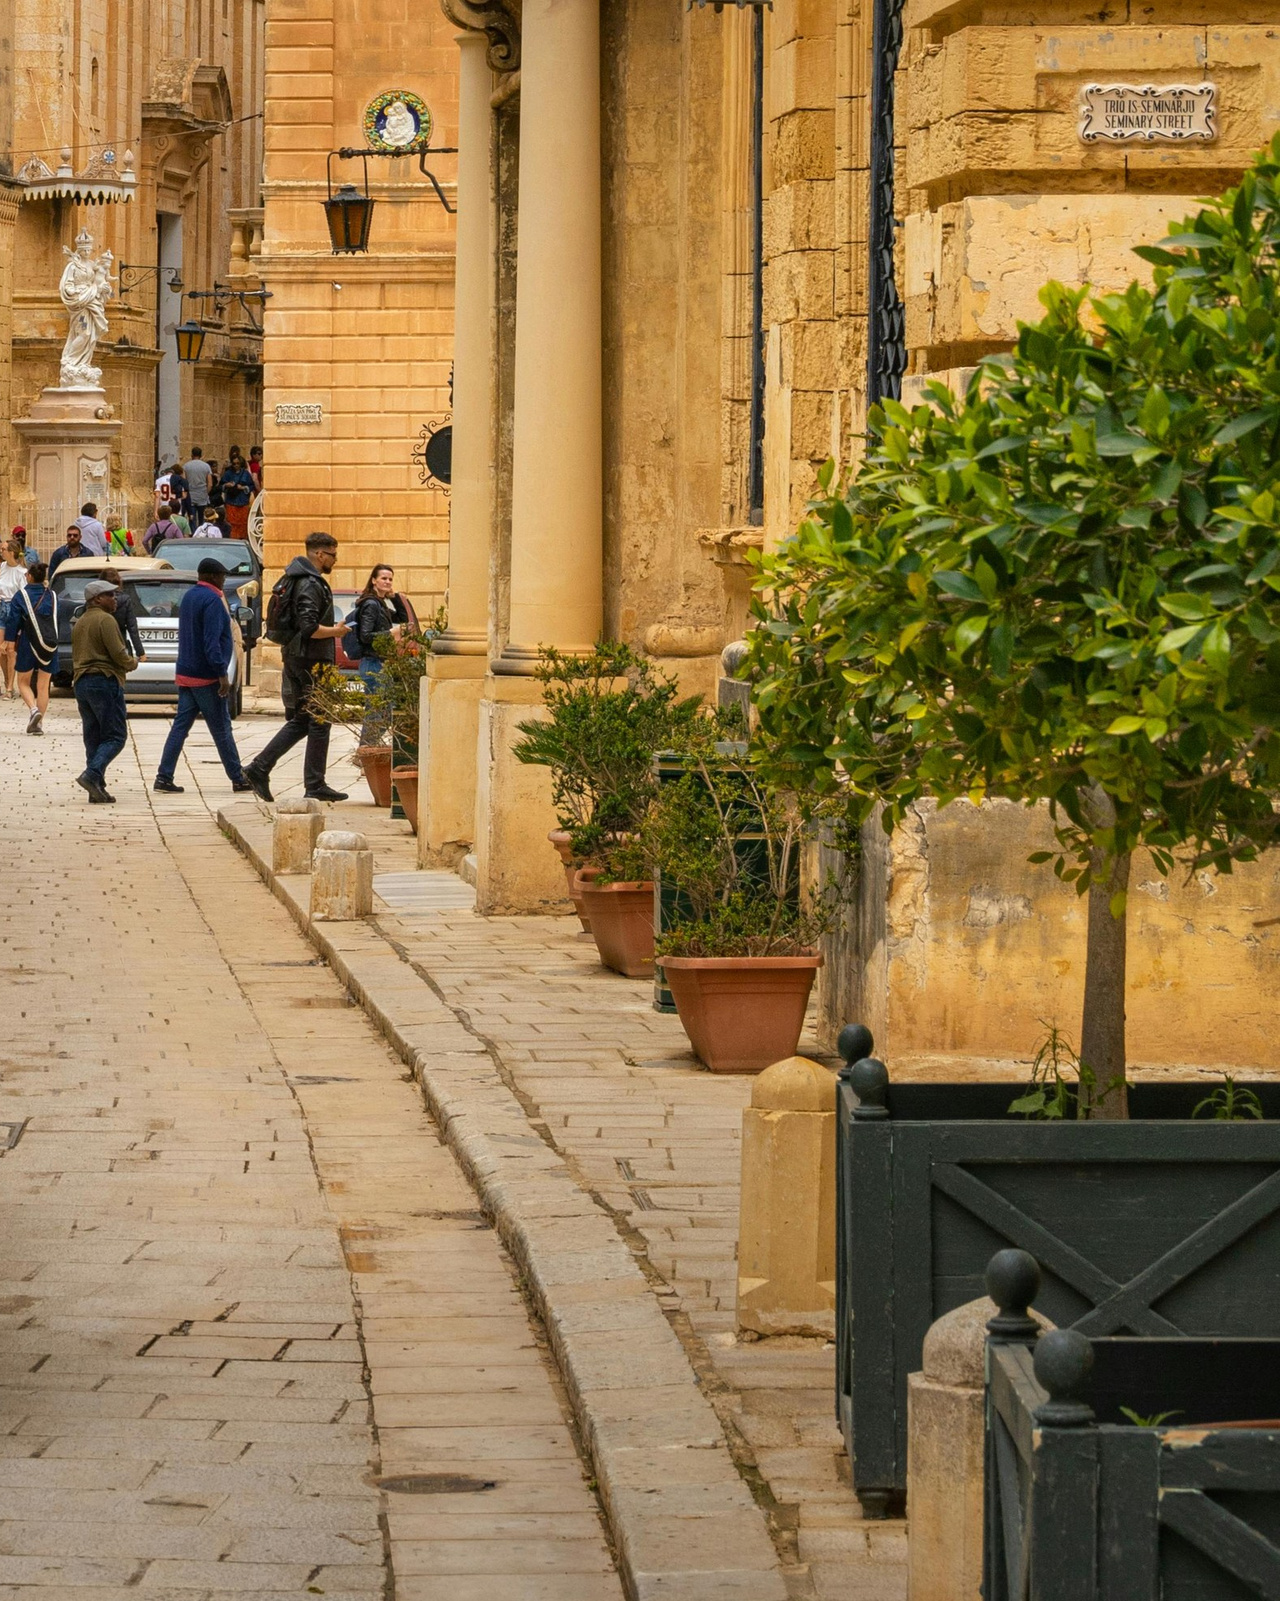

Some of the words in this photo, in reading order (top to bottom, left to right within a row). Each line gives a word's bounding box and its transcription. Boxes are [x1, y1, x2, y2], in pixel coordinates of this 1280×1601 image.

[1103, 99, 1126, 114] TRIQ
[1128, 99, 1195, 114] IS-SEMINARJU
[1104, 114, 1154, 129] SEMINARY
[1156, 114, 1194, 129] STREET
[140, 630, 158, 640] SZT
